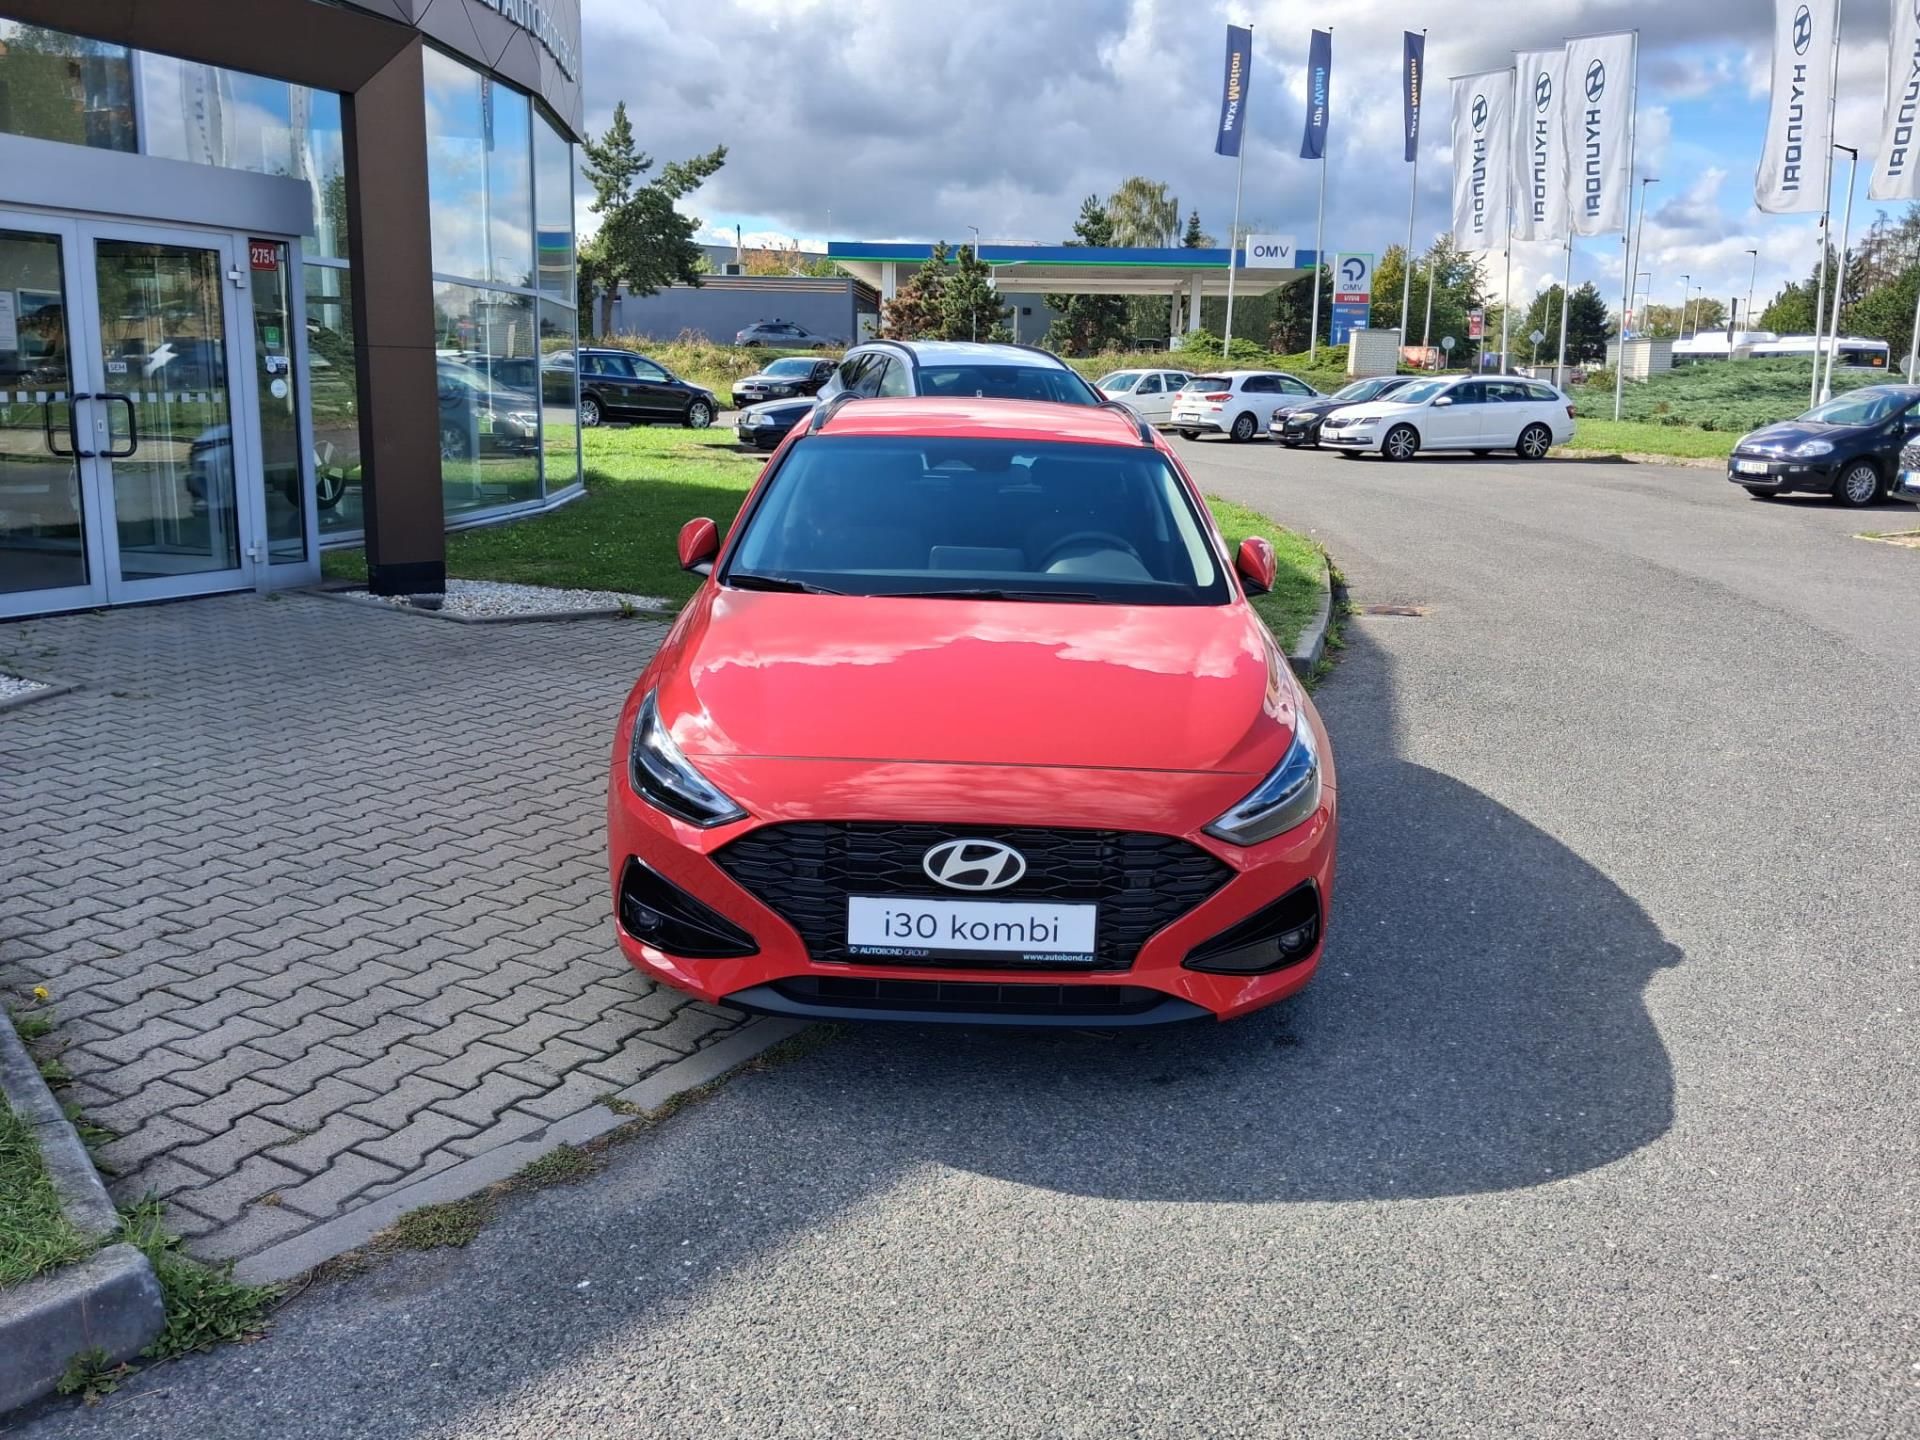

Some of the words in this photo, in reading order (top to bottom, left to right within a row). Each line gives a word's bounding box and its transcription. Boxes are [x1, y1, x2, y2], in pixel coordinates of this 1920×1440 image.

[252, 248, 275, 264] 2754
[1253, 245, 1290, 258] OMV
[1342, 283, 1364, 291] OMV
[884, 910, 938, 939] i30
[950, 914, 1059, 942] kombi
